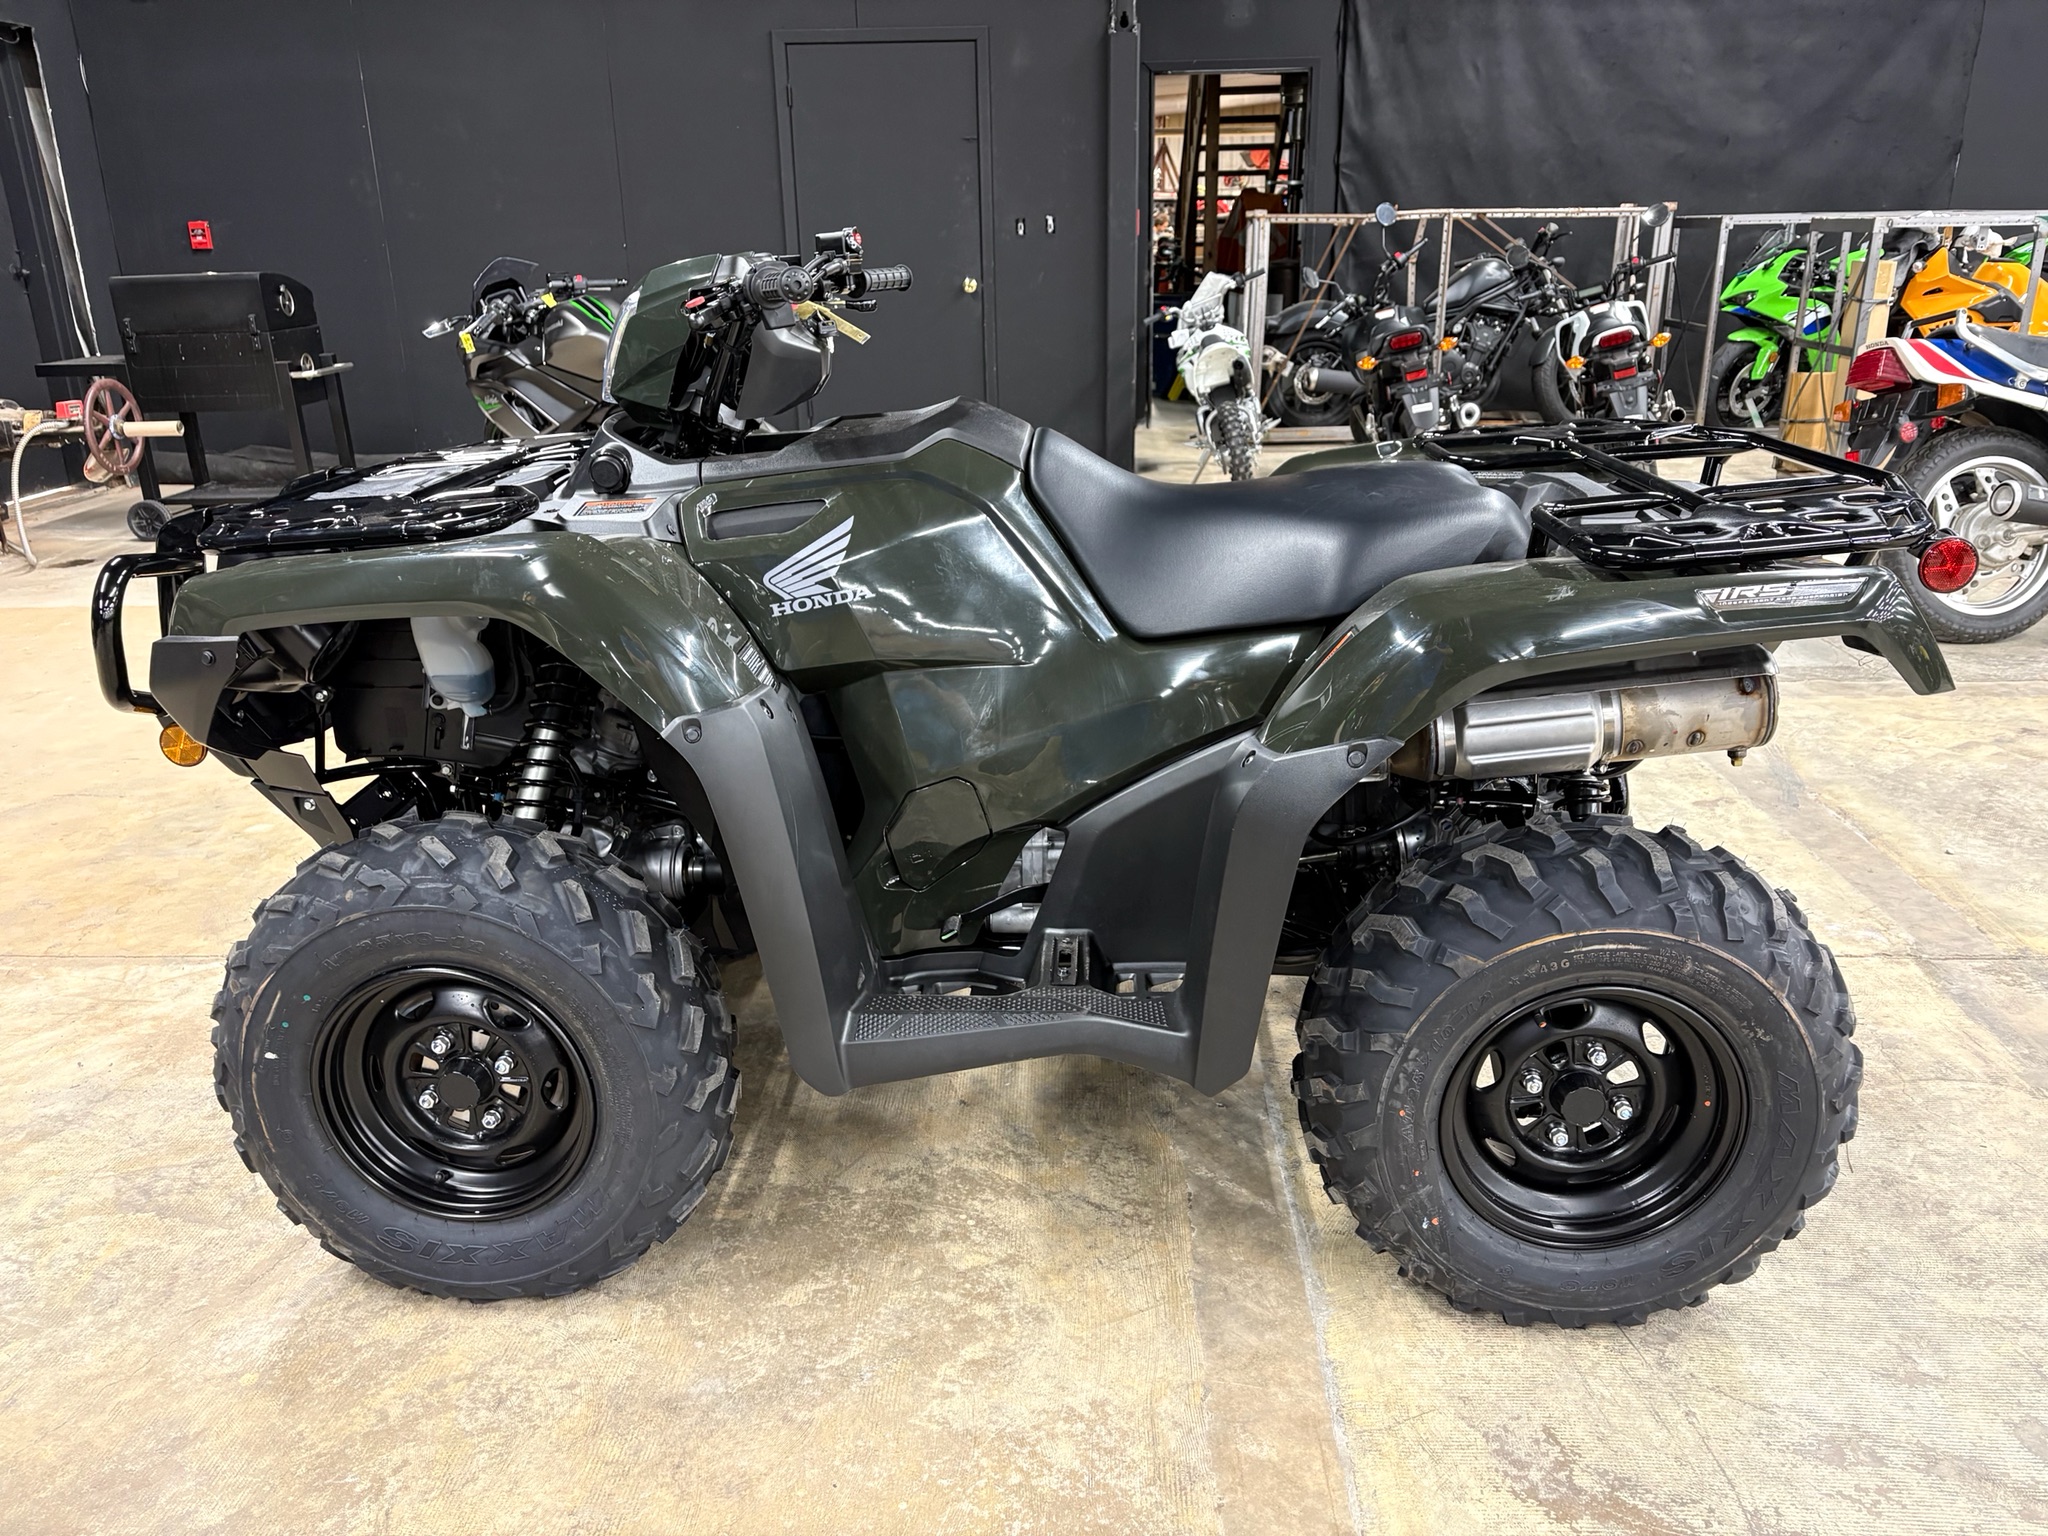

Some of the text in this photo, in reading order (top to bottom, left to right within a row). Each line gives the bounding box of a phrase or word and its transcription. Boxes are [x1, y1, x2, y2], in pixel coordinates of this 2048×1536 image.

[1865, 340, 1889, 350] HONDA
[769, 585, 876, 618] HONDA
[1718, 583, 1794, 600] IRS
[1660, 1070, 1802, 1279] MAXXIS
[376, 1188, 612, 1266] MAXXIS
